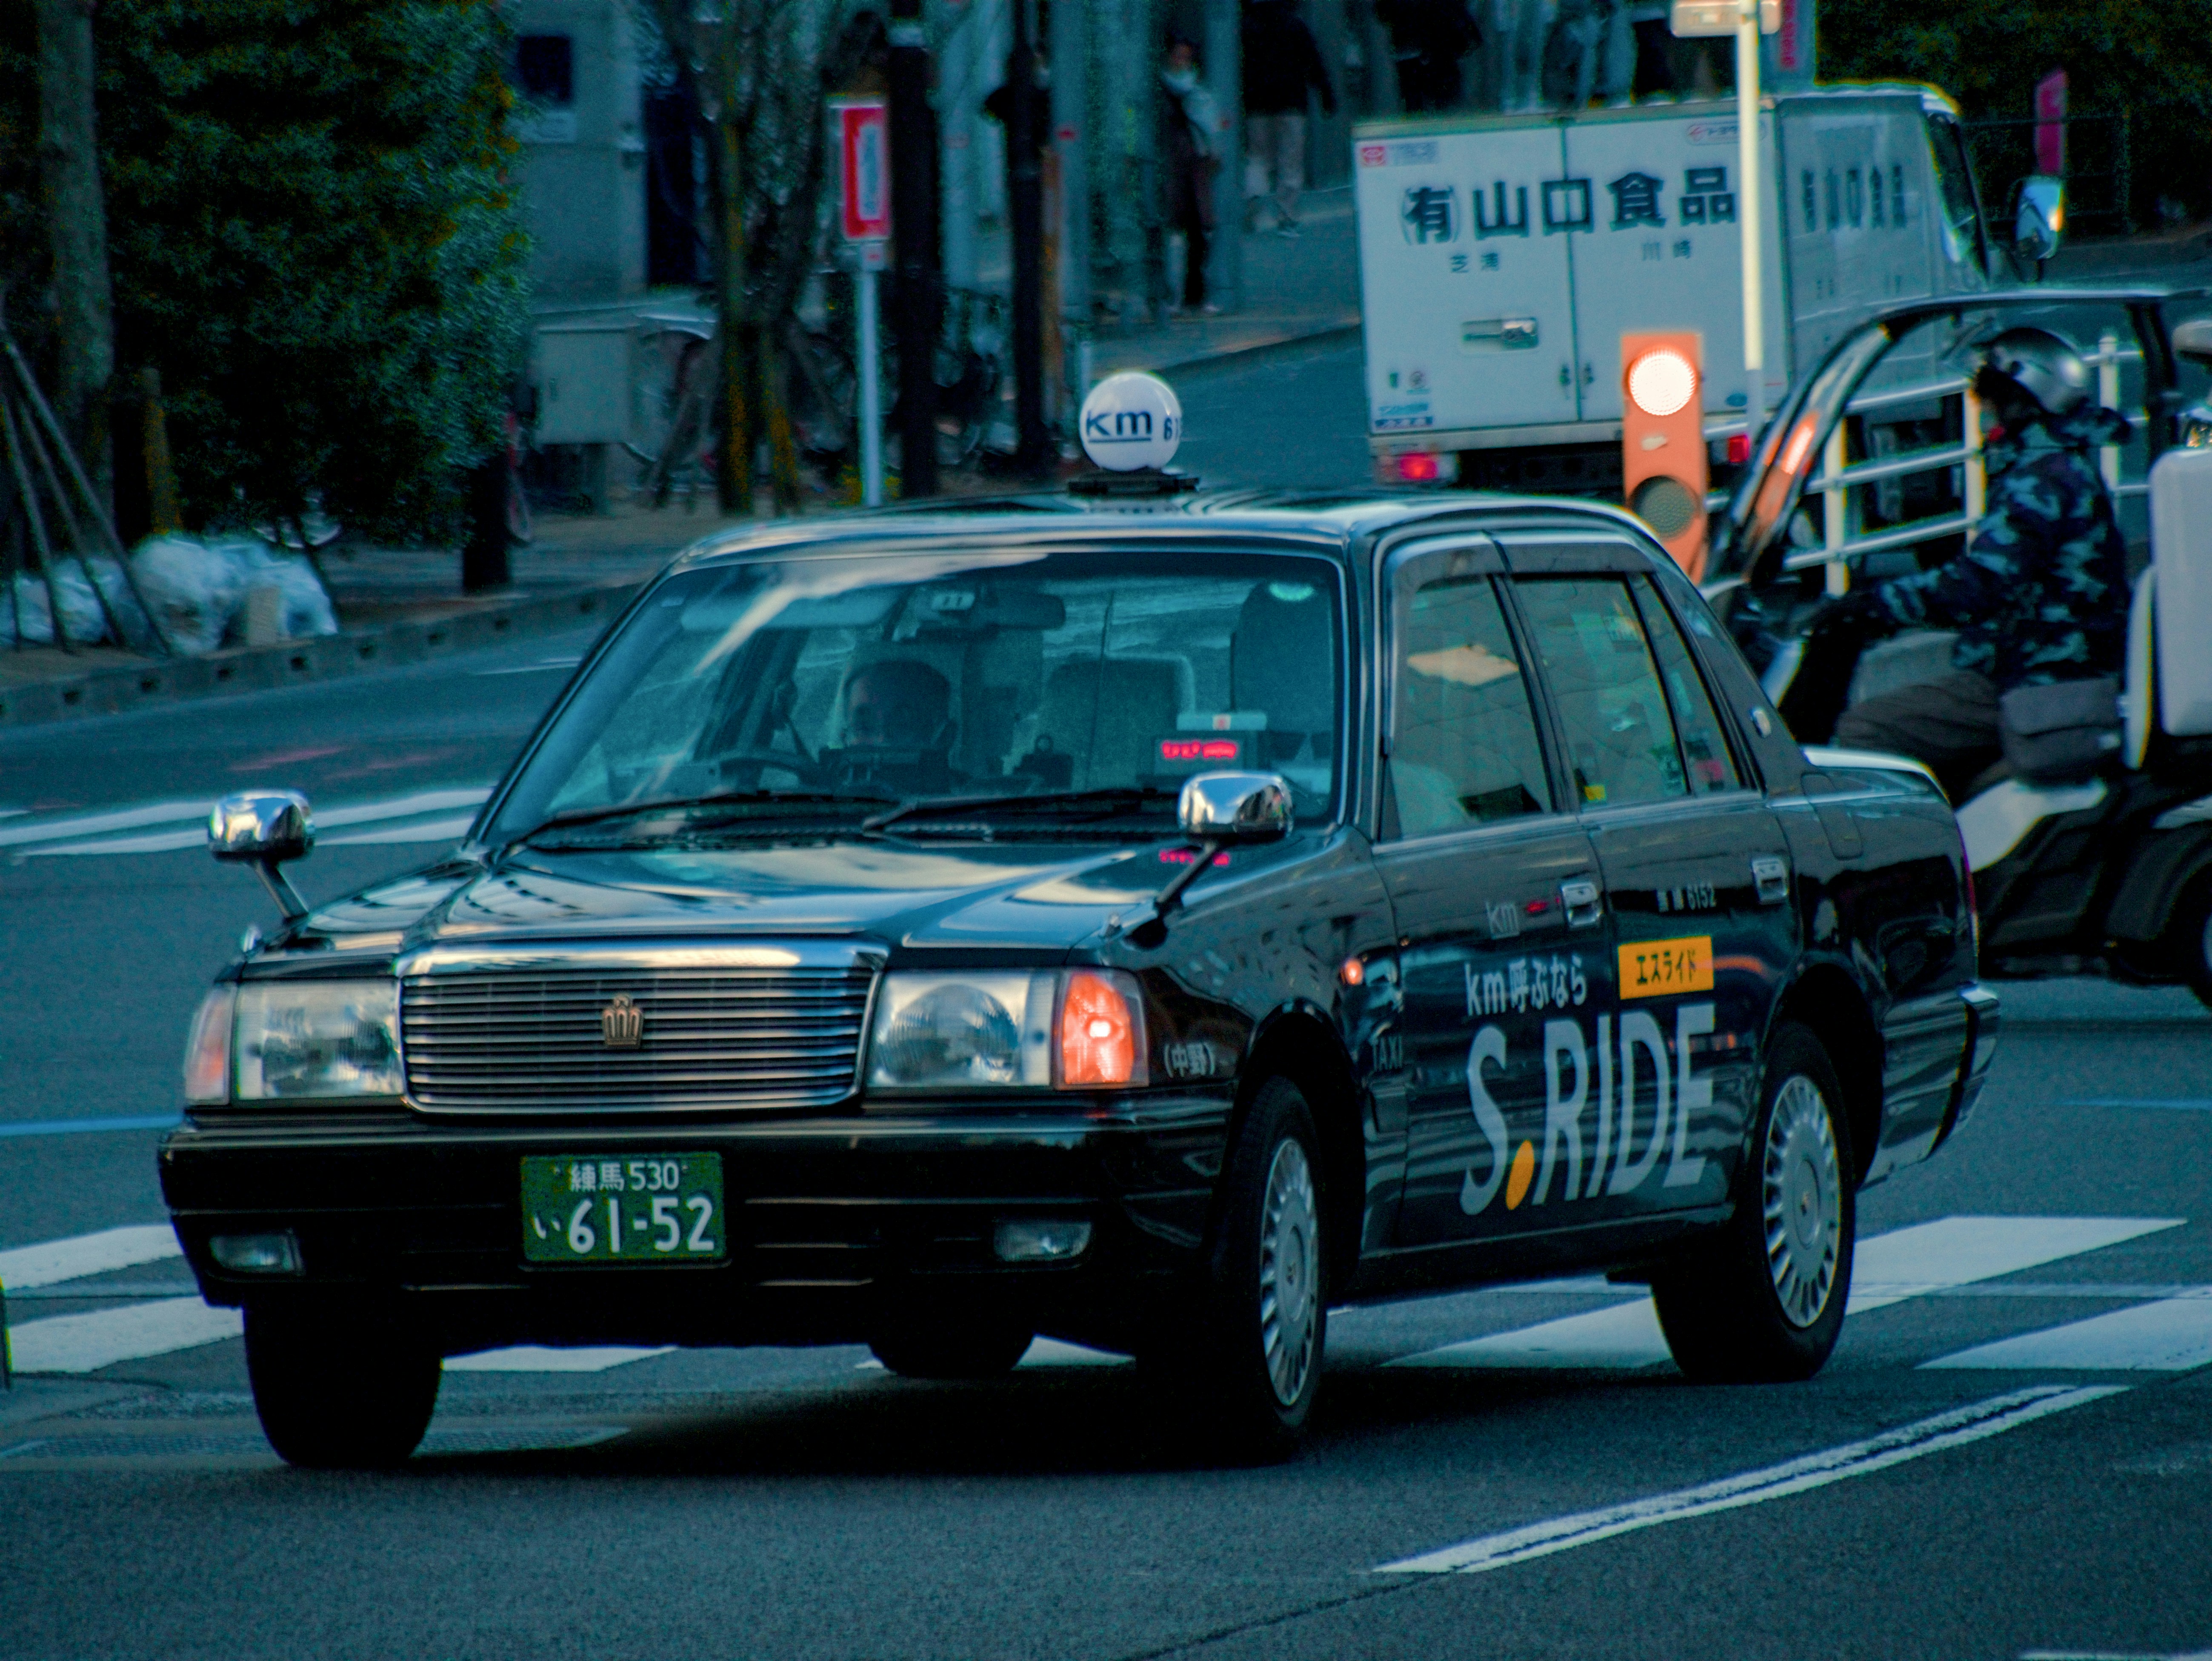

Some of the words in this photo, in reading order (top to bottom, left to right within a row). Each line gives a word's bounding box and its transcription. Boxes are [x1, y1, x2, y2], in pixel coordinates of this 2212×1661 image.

[1086, 409, 1152, 437] km
[1485, 900, 1520, 935] km
[1636, 948, 1696, 986] エスライド
[1372, 1034, 1403, 1070] TAXI
[1460, 1002, 1715, 1216] S.RIDE
[629, 1161, 680, 1191] 530
[532, 1213, 561, 1240] い
[568, 1196, 715, 1254] 61-52
